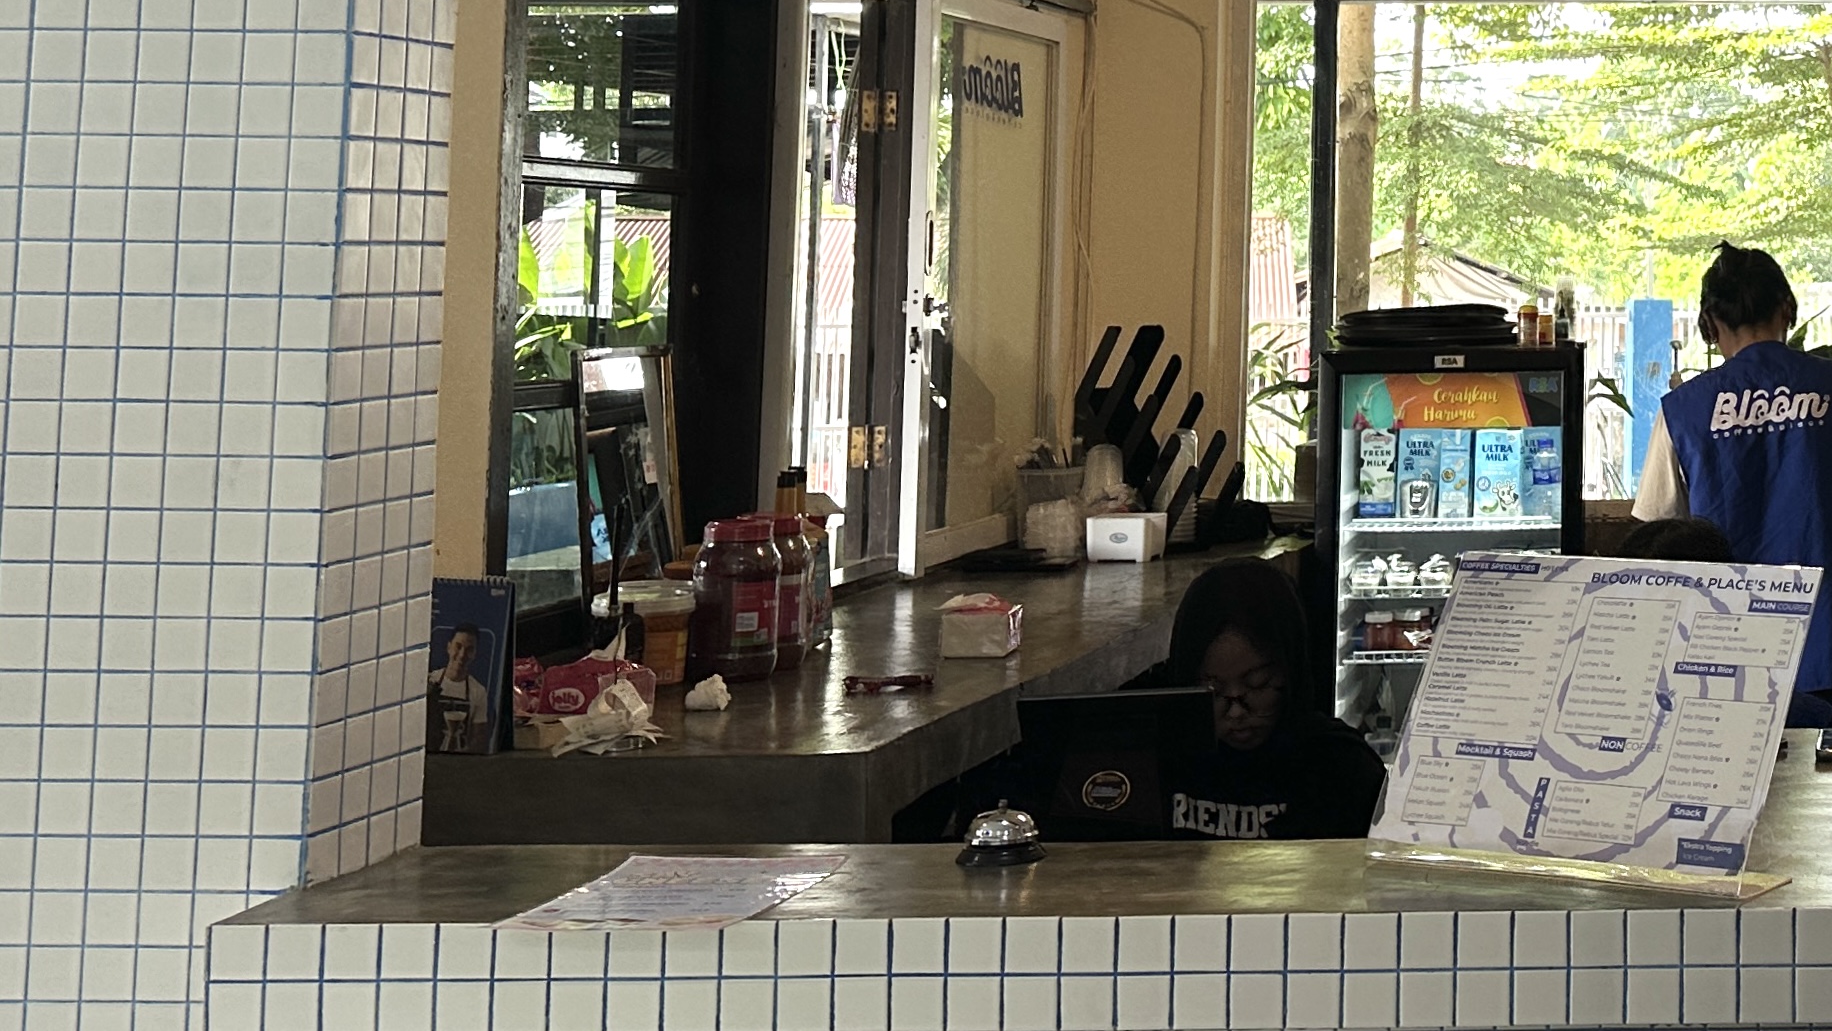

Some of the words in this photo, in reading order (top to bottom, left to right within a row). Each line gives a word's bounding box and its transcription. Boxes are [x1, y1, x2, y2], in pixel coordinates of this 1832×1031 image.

[1433, 385, 1500, 405] Cerahkan
[1406, 441, 1435, 449] ULTRA
[1481, 444, 1514, 453] ULTRA
[1409, 449, 1431, 457] MILK
[1485, 453, 1509, 462] MILK
[1591, 572, 1642, 585] BLOOM
[1645, 575, 1692, 587] COFFE
[1693, 577, 1704, 588] &
[1706, 578, 1767, 591] PLACE'S
[1769, 581, 1814, 594] MENU
[1752, 601, 1776, 610] MAIN
[1677, 663, 1708, 673] Chicken
[1458, 744, 1493, 754] Mocktail
[1601, 740, 1624, 750] NON
[1526, 779, 1547, 834] PASTA
[1673, 807, 1702, 817] Snack
